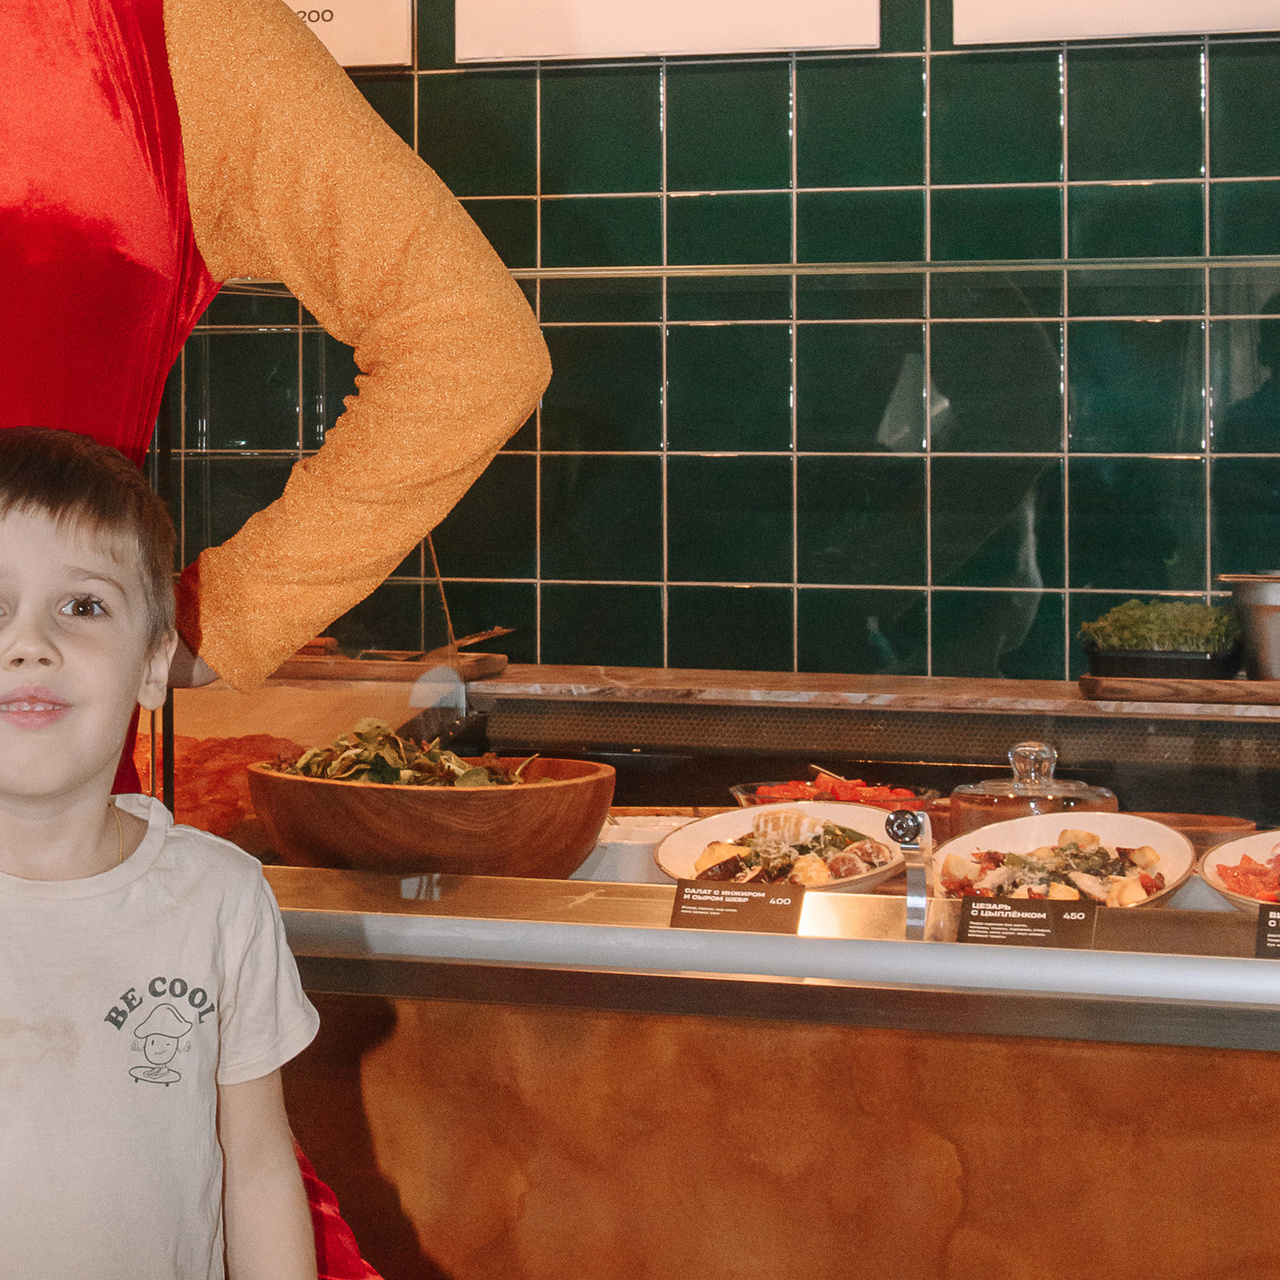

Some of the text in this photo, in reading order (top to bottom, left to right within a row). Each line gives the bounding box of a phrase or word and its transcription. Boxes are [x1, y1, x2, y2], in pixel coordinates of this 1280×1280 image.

[297, 9, 334, 23] 200
[769, 897, 792, 905] 400
[972, 902, 1012, 911] ЦЕЗАРЬ
[1063, 912, 1086, 920] 450
[104, 977, 215, 1031] BE COOL
